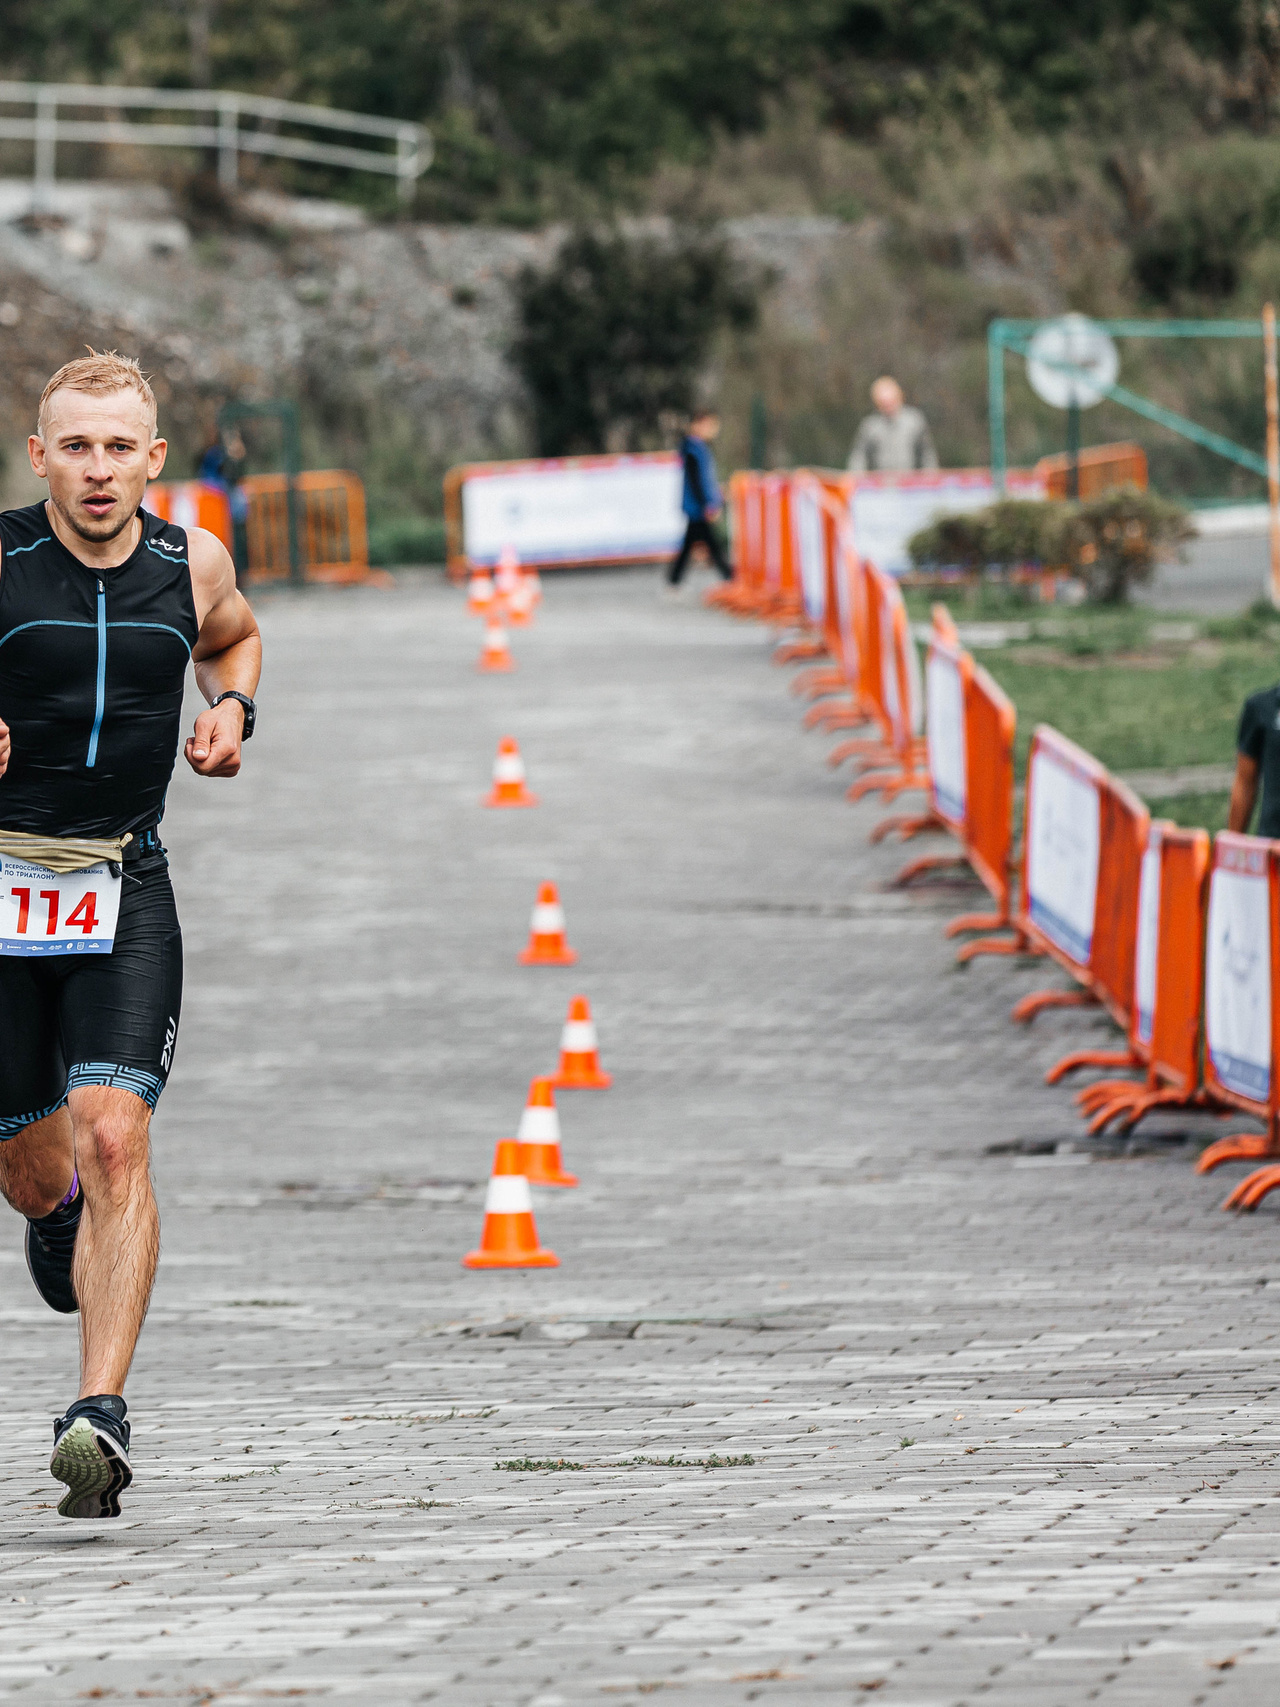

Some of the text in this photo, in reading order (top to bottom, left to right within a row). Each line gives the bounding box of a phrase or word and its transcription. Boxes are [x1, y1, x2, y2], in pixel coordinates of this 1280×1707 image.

[16, 871, 56, 880] ТРИАТЛОНУ
[11, 887, 99, 935] 114
[160, 1016, 176, 1073] 2XU
